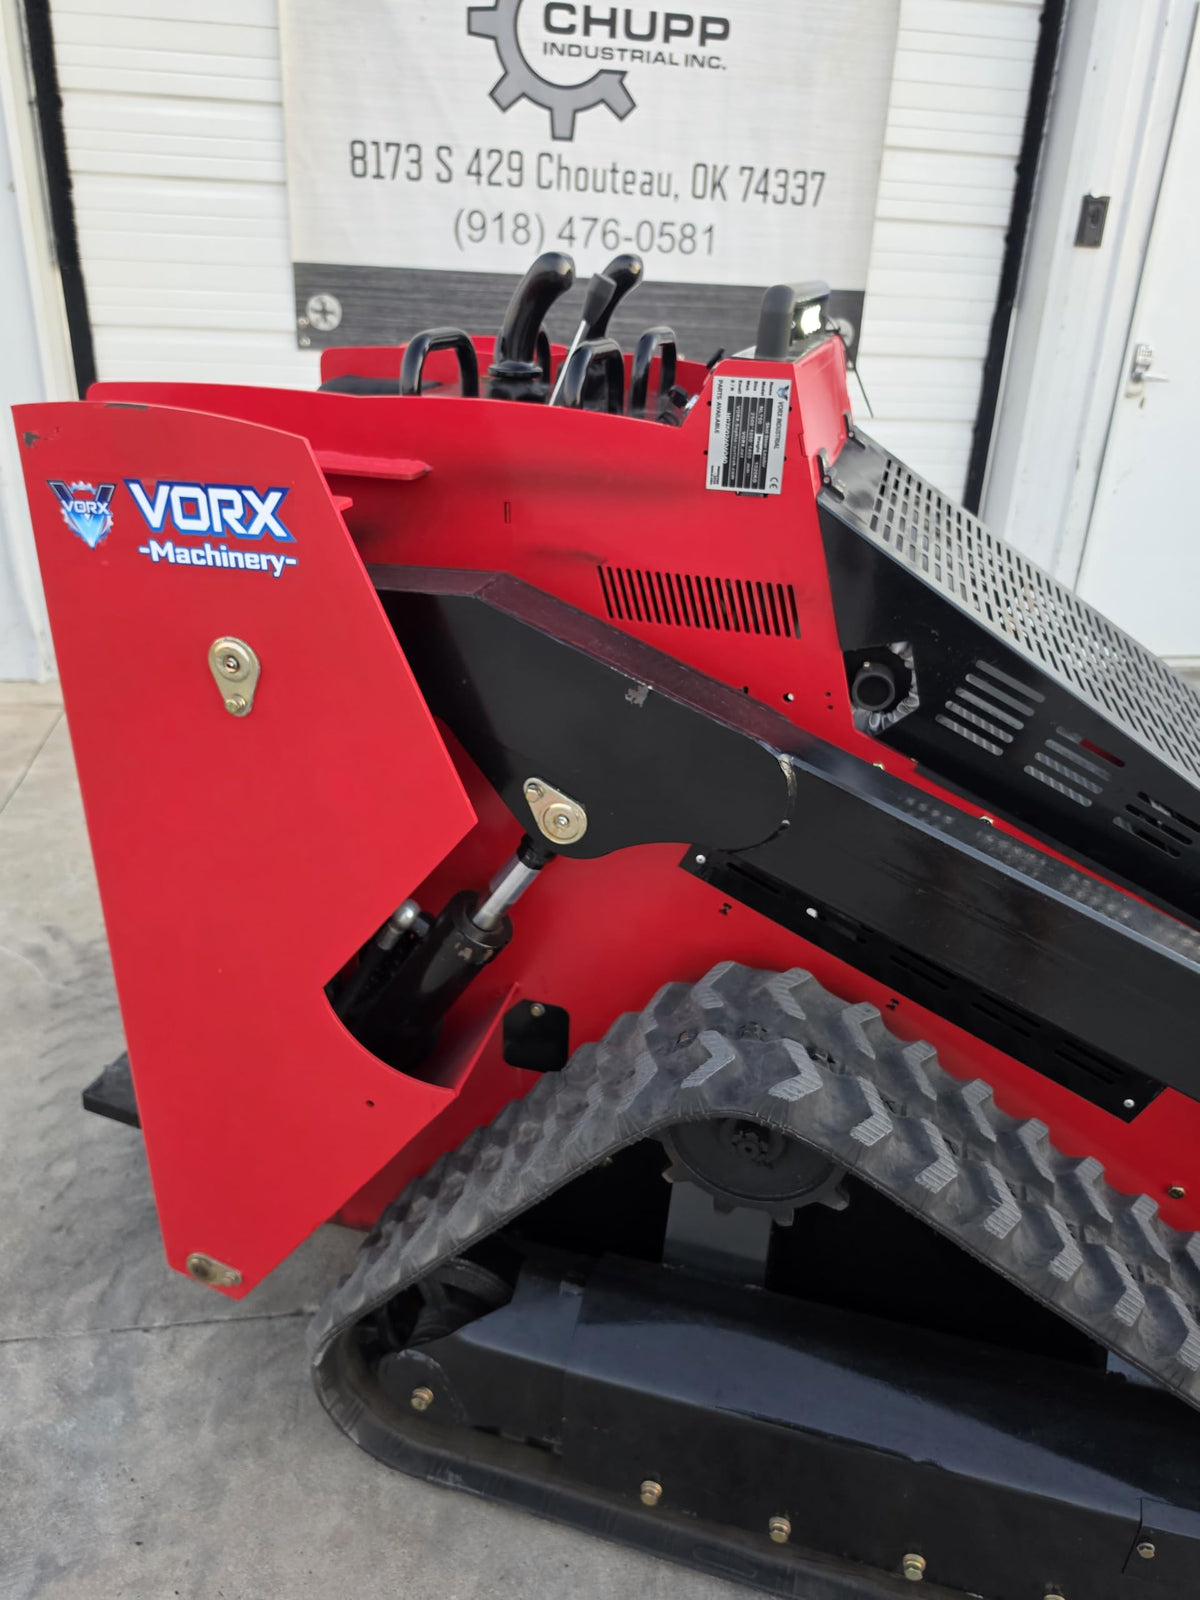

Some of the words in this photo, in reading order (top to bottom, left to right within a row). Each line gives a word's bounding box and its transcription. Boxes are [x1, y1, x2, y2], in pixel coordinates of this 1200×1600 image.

[543, 2, 730, 47] CHUPP
[543, 41, 680, 67] INDUSTRIAL
[684, 53, 728, 70] INC.
[349, 139, 423, 182] 8173
[435, 145, 453, 184] S
[467, 148, 525, 188] 429
[537, 151, 680, 201] Chouteau,
[691, 162, 728, 201] OK
[738, 165, 826, 207] 74337
[453, 208, 545, 252] (918)
[557, 216, 716, 256] 476-0581
[774, 419, 782, 449] INDUSTRIAL
[61, 500, 111, 515] VORX
[123, 477, 296, 542] VORX
